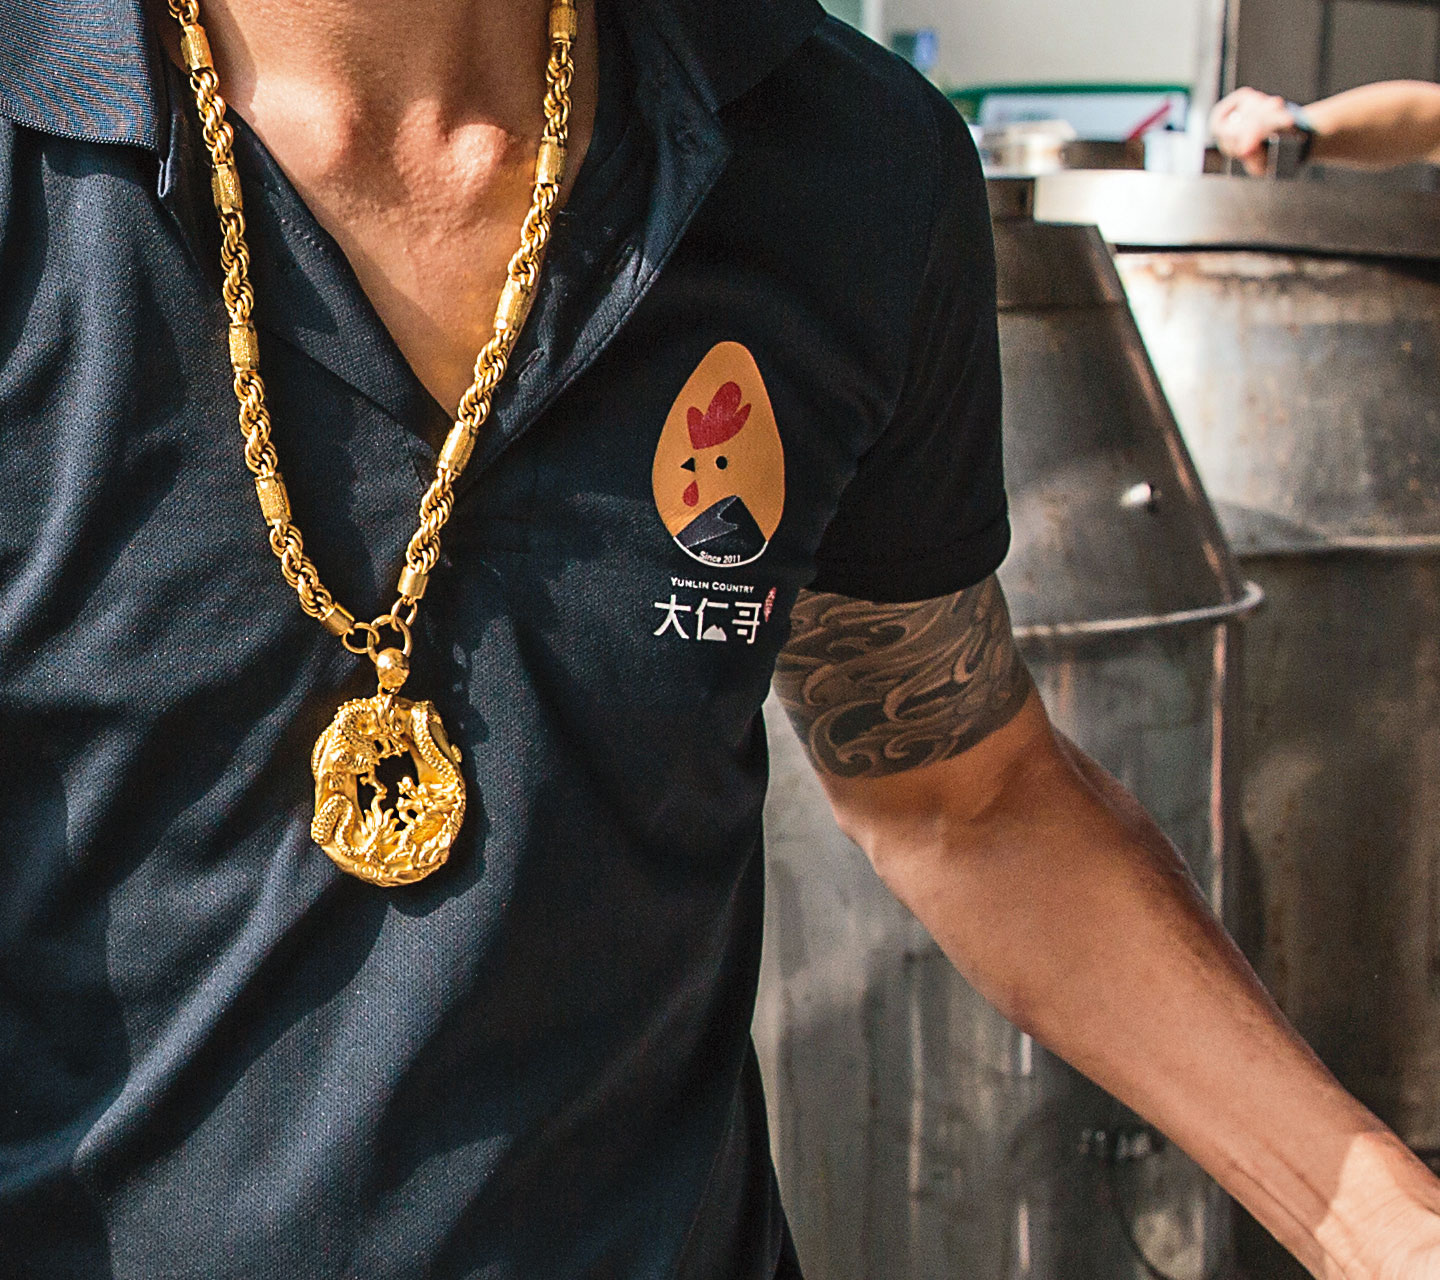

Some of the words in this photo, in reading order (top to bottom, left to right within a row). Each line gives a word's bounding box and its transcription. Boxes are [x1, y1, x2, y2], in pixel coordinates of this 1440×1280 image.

[699, 550, 722, 564] Since
[723, 554, 741, 565] 2011
[712, 581, 755, 594] COUNTRY
[653, 594, 763, 645] 大仁哥
